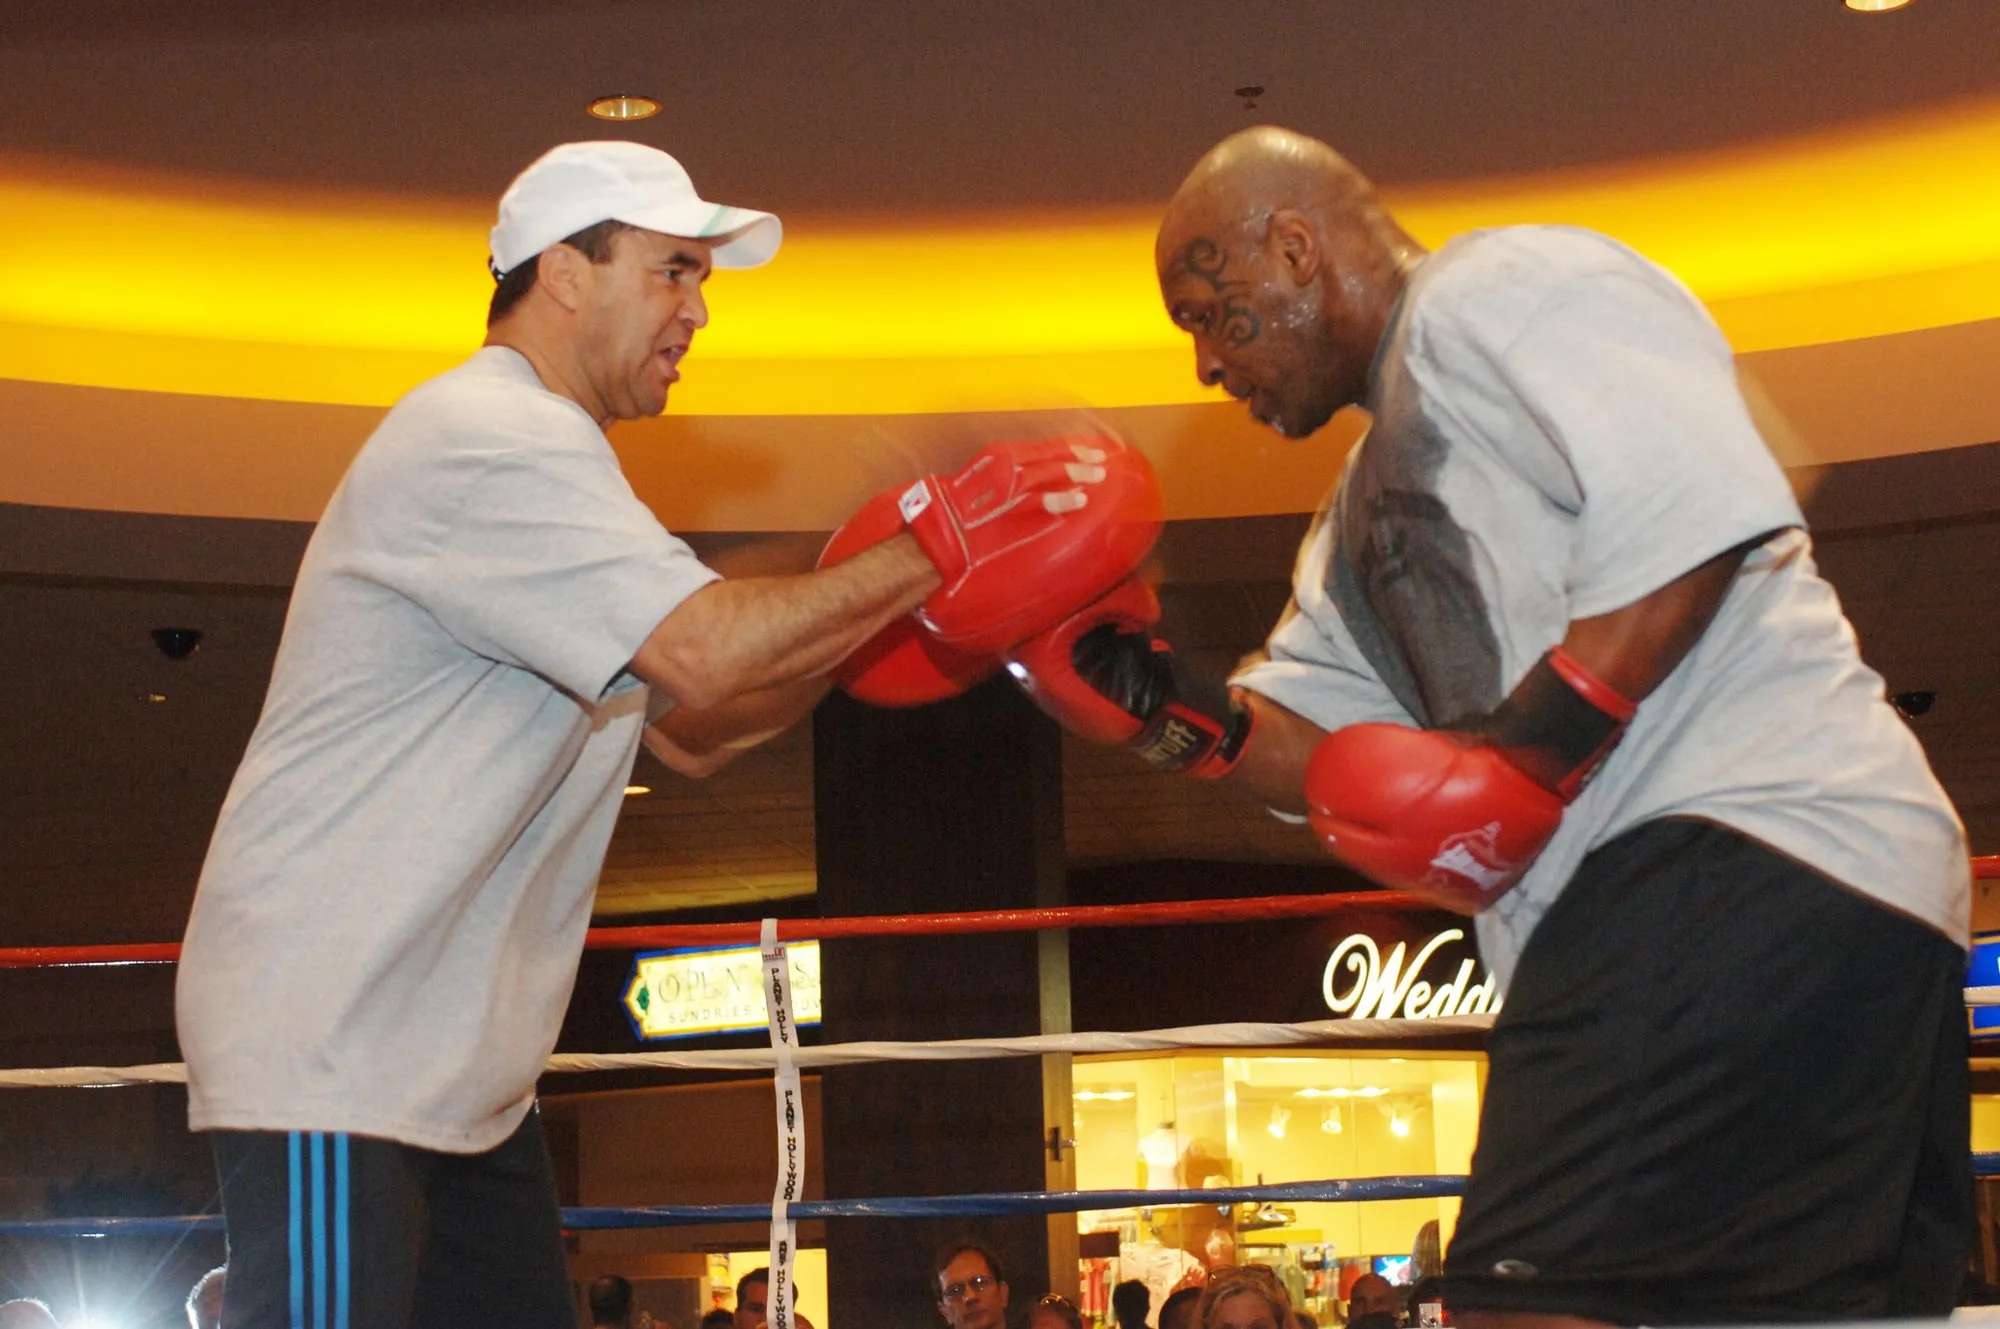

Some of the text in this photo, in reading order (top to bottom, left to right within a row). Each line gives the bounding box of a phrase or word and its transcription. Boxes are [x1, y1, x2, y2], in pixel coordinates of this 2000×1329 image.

[771, 967, 783, 1006] PLANET
[668, 1004, 751, 1025] SUNDRIES
[776, 1009, 788, 1044] HOLLY
[784, 1089, 797, 1201] PLANET HOLLYWOOD
[775, 1240, 788, 1329] ANET HOLLYWOO
